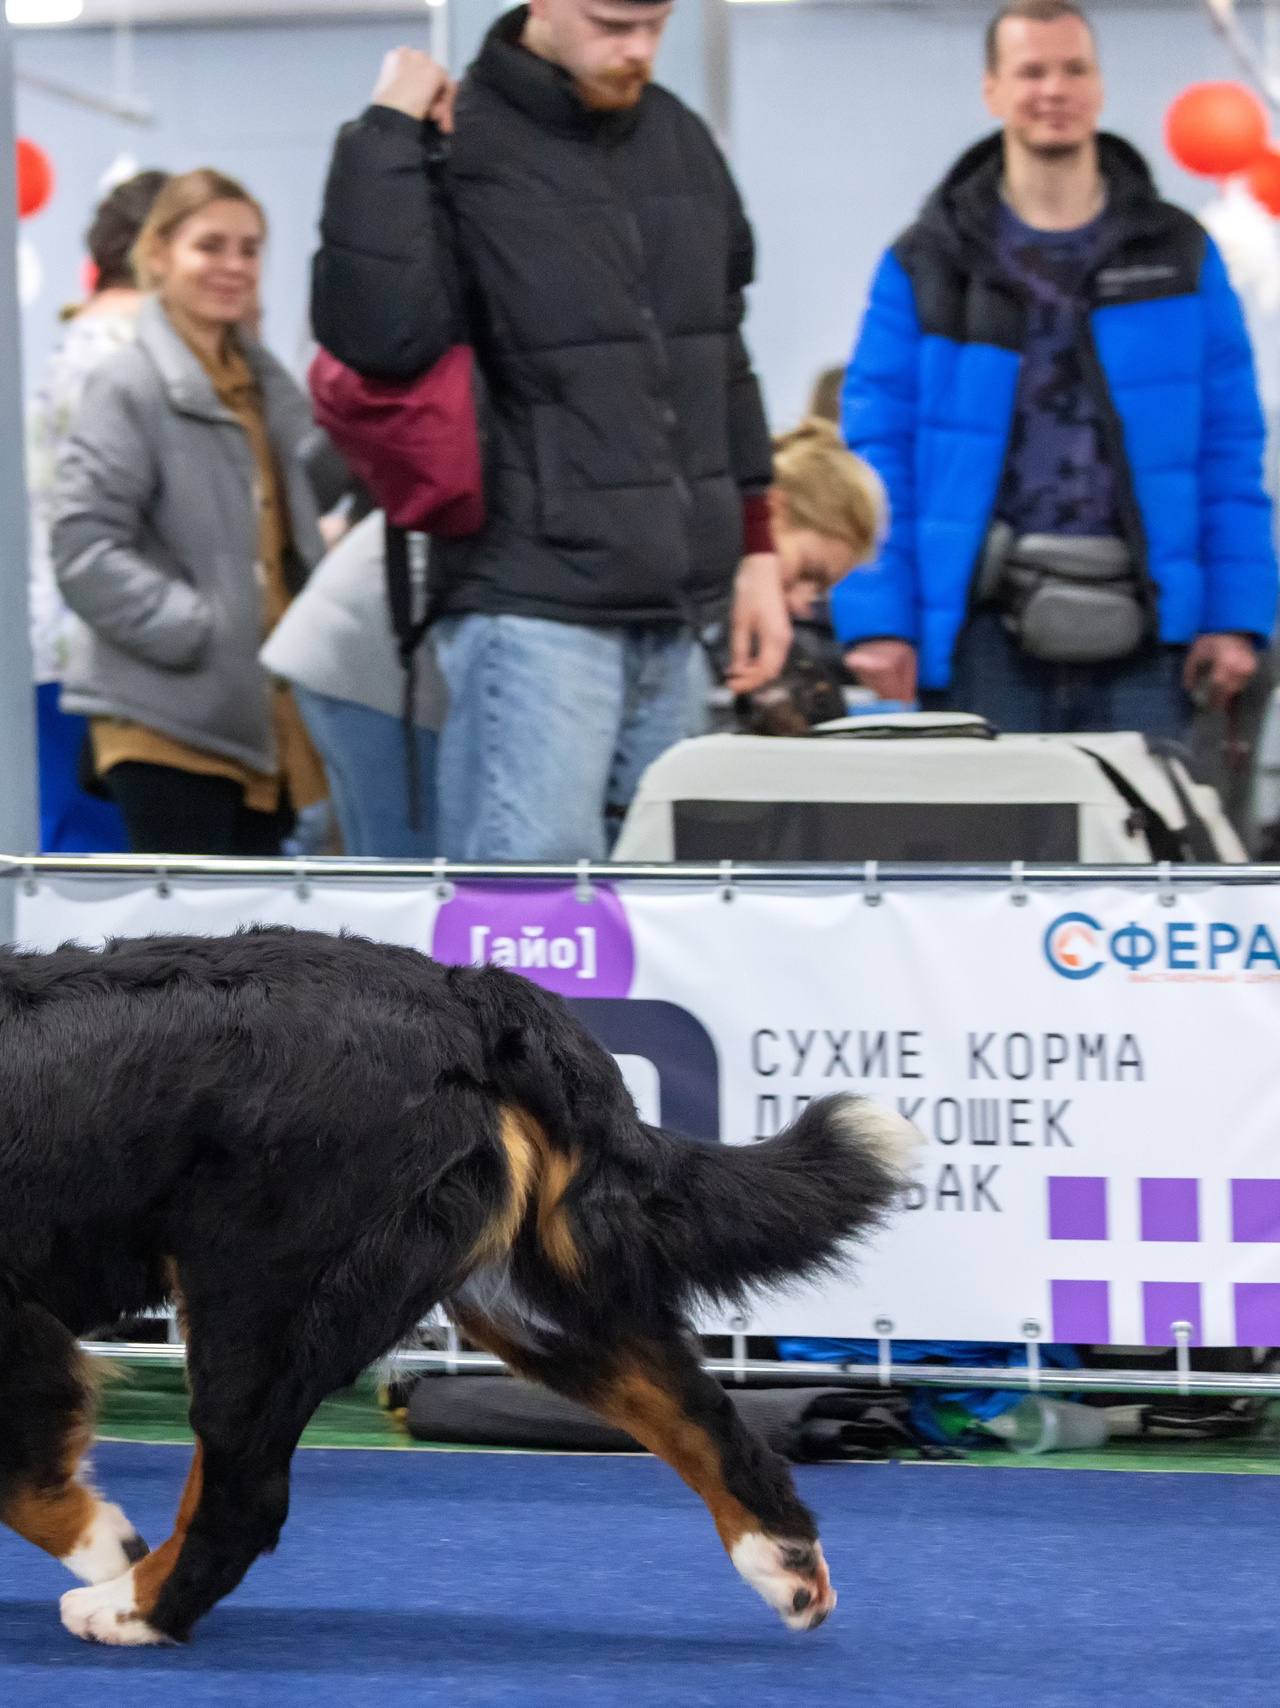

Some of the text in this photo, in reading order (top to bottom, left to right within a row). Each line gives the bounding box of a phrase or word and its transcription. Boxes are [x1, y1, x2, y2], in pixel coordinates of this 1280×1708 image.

[1045, 911, 1280, 980] СФЕРА
[751, 1028, 1145, 1081] СУХИЕ КОРМА
